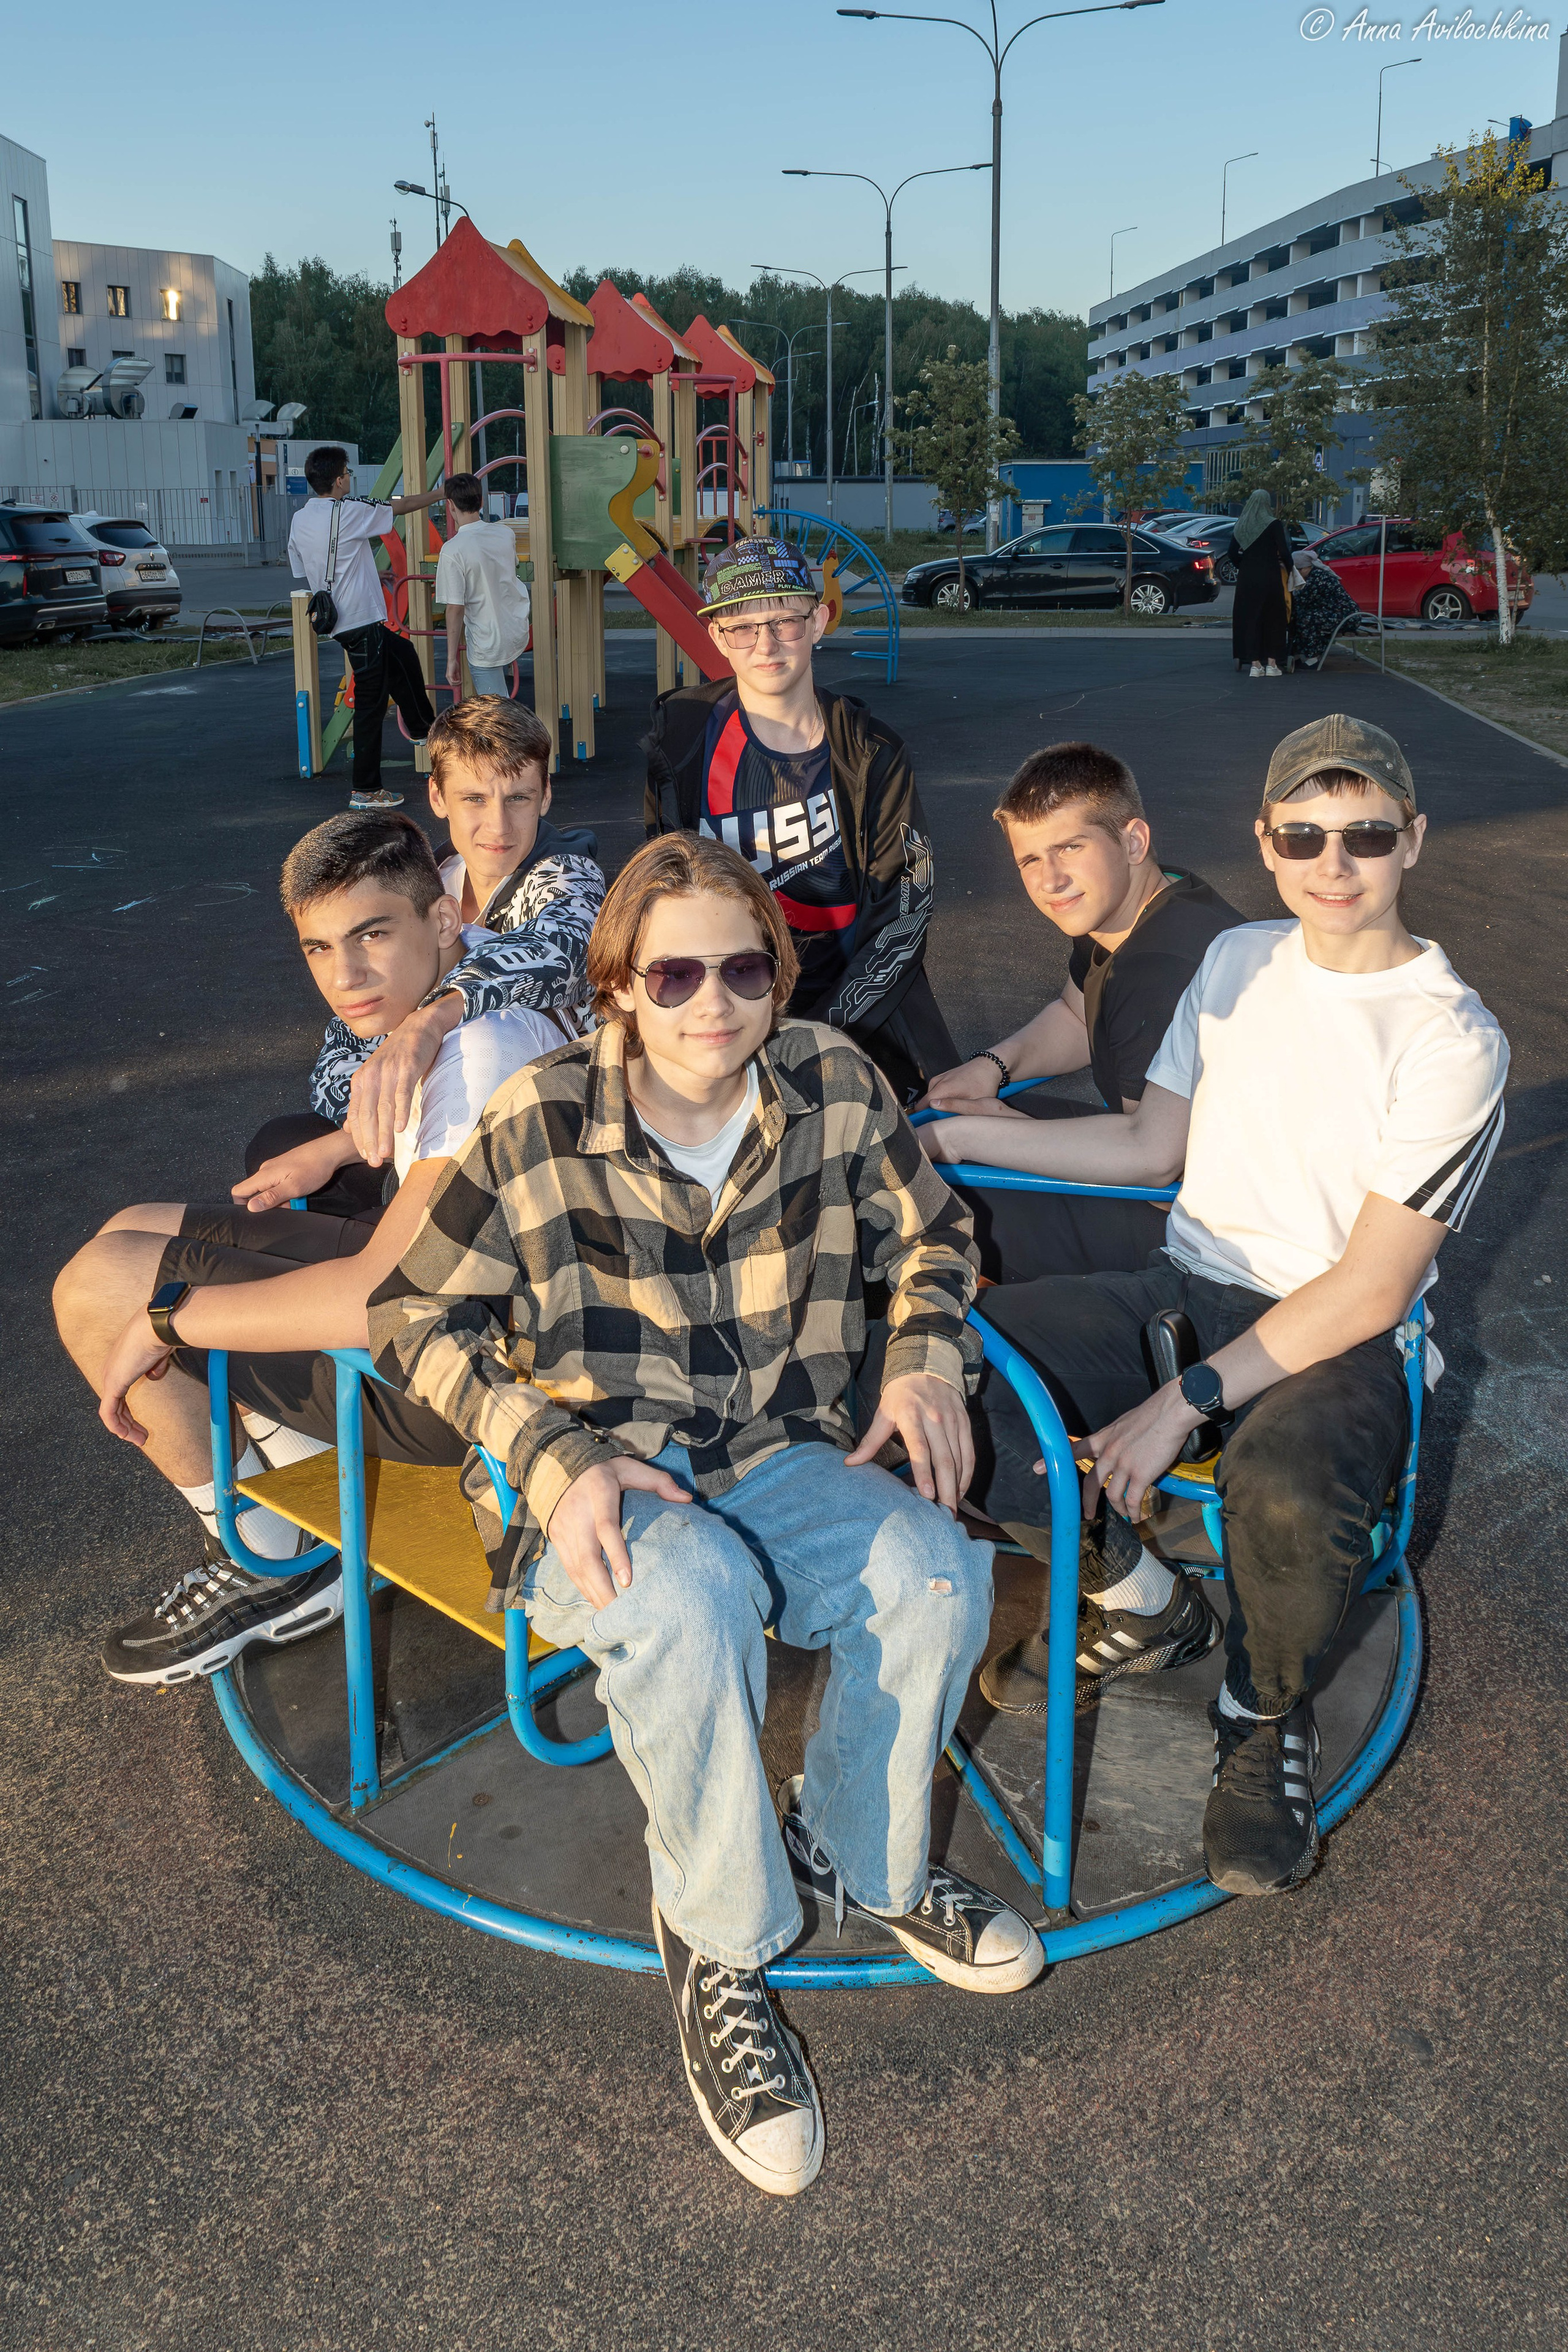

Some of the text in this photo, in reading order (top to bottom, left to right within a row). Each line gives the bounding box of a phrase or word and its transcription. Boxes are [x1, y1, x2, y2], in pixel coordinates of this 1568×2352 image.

[721, 570, 785, 594] GAMER
[699, 789, 840, 874] USSI
[769, 861, 809, 891] RUSSIAN
[809, 848, 828, 866] TEAM
